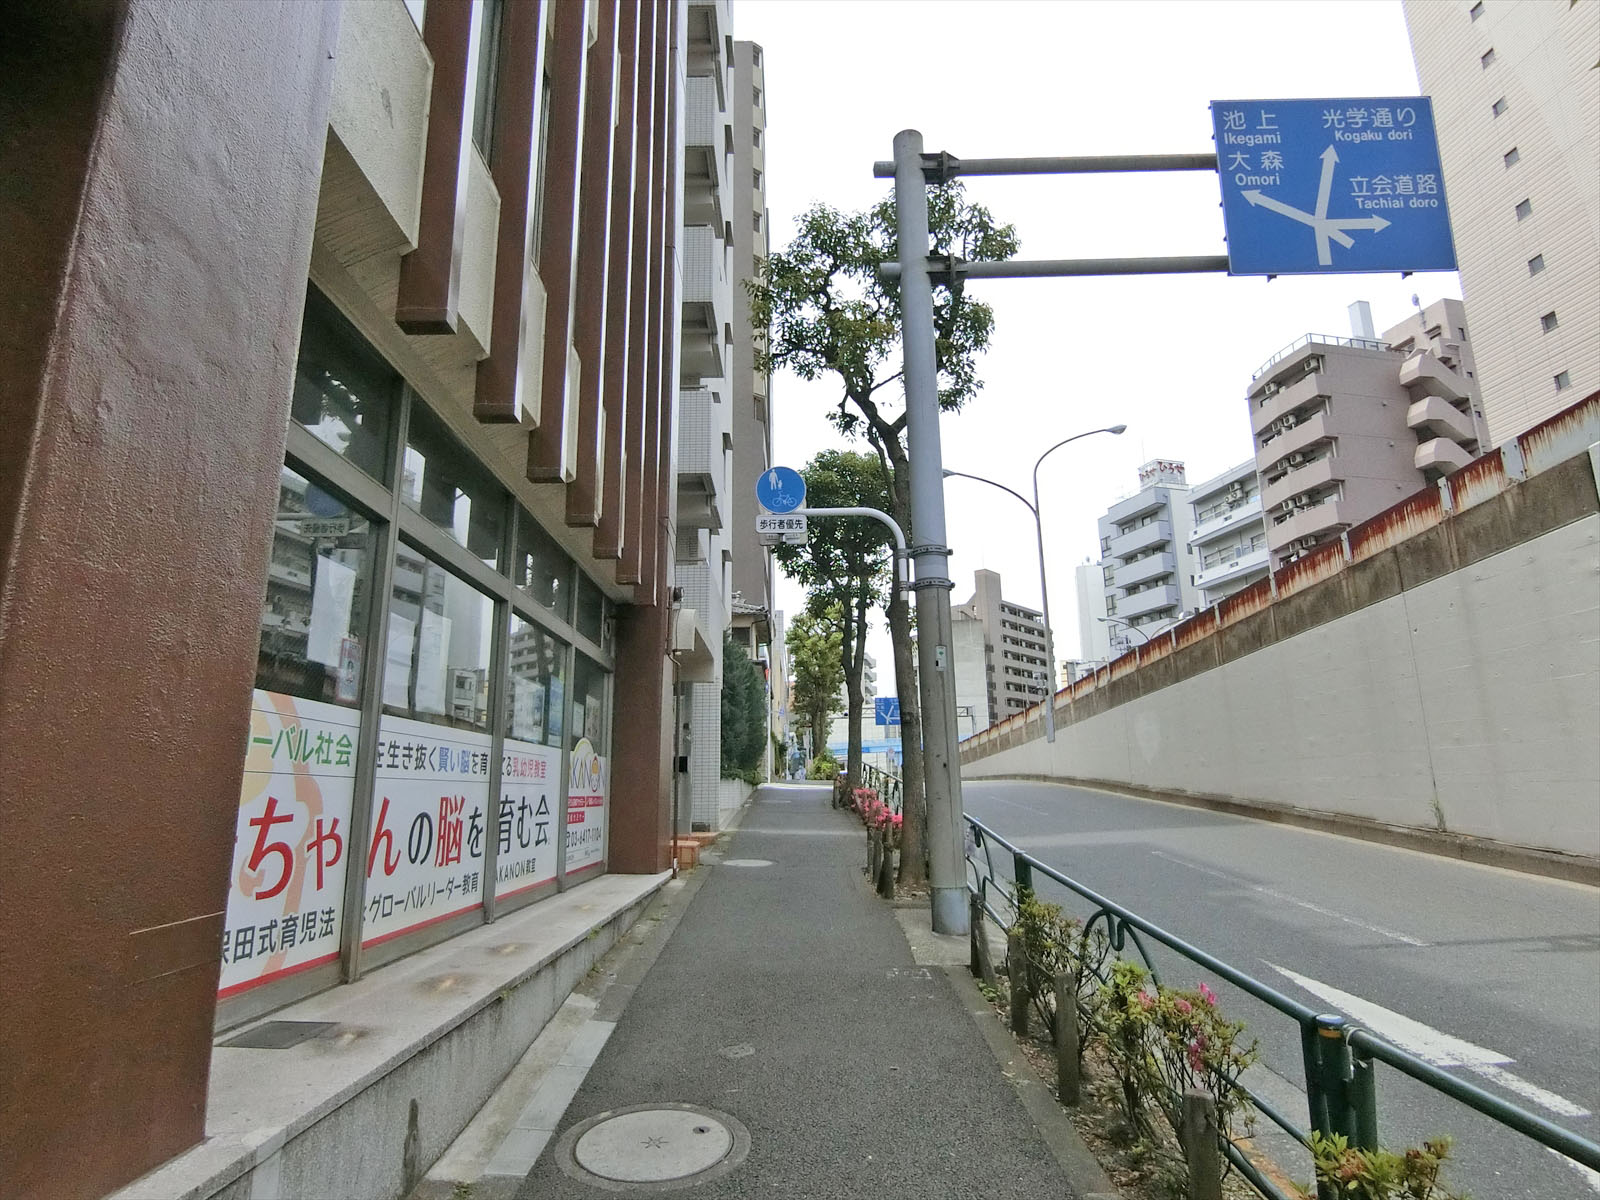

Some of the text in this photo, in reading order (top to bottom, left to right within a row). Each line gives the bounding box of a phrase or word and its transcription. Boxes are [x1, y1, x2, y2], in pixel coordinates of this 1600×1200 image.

[1223, 109, 1279, 131] 池上
[1322, 107, 1416, 129] 光学通り
[1223, 132, 1281, 147] Ikegami
[1334, 129, 1413, 144] Kogaku dori
[1228, 150, 1284, 172] 大森
[1235, 172, 1281, 186] Omori
[1349, 173, 1438, 196] 立会道路
[1357, 196, 1438, 209] Tachiai doro
[759, 518, 804, 530] 歩行者優先
[247, 724, 353, 767] ーバル社会
[233, 796, 343, 900] ちゃ
